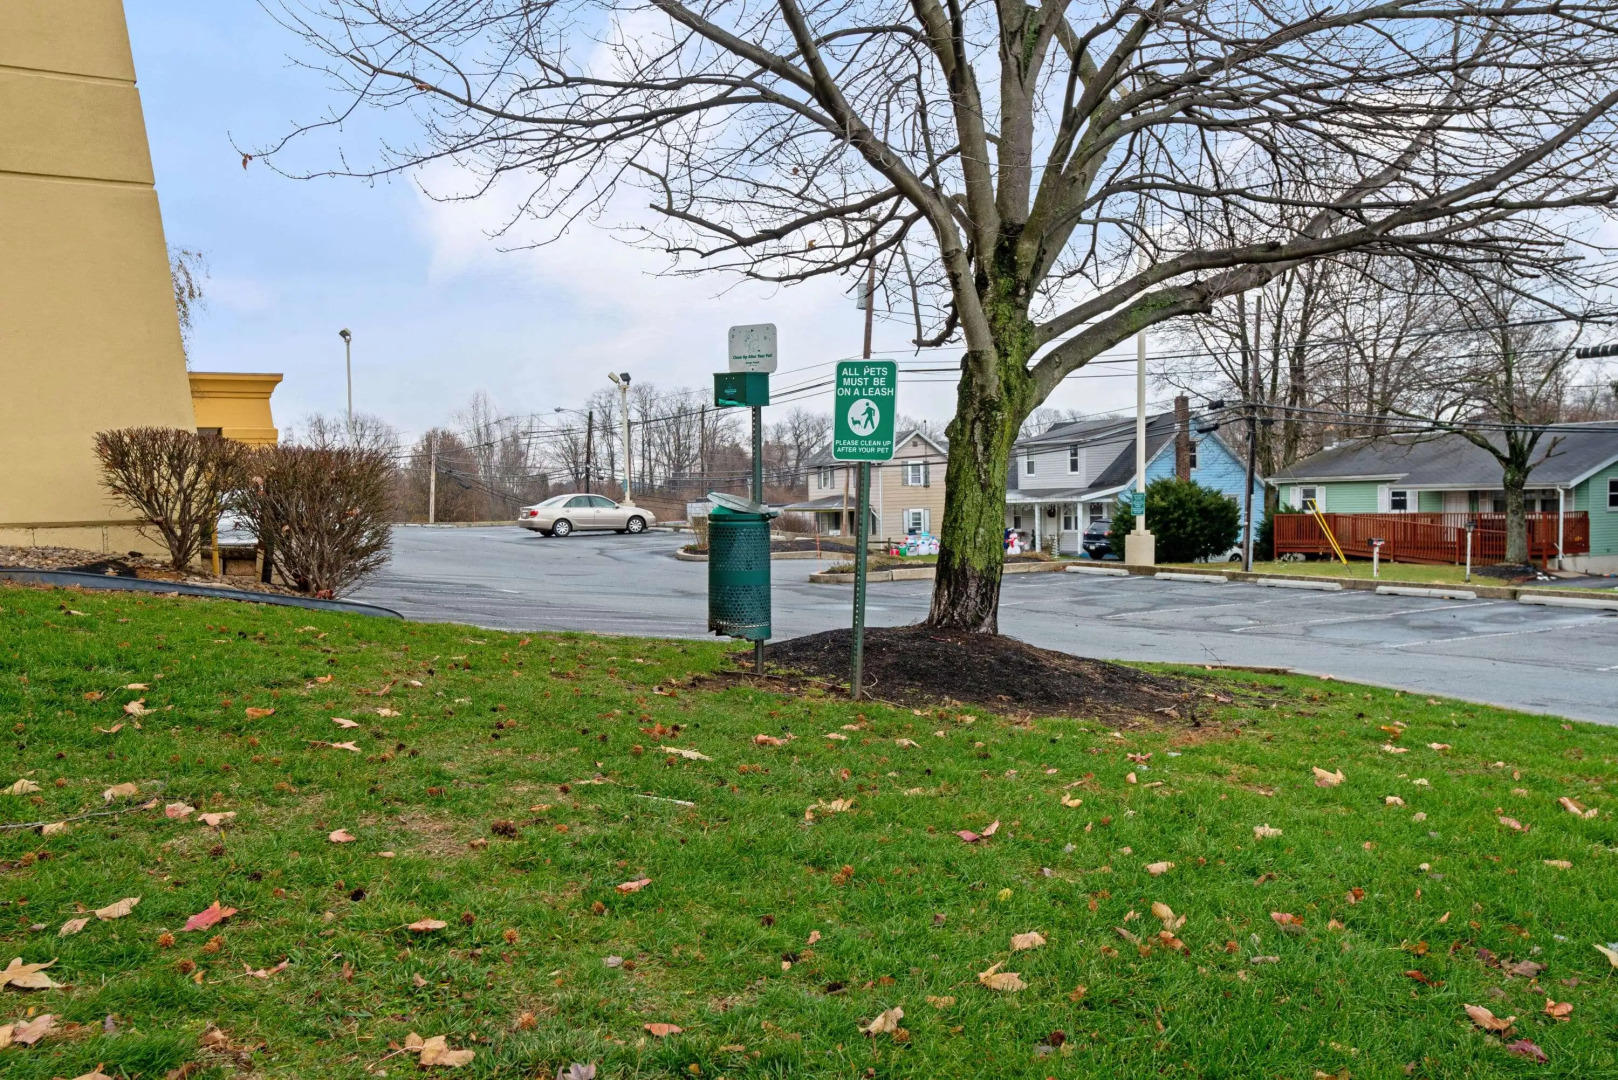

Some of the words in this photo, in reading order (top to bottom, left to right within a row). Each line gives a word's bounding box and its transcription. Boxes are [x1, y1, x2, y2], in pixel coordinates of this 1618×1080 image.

[842, 368, 860, 376] ALL
[864, 367, 888, 376] PETS
[842, 378, 869, 386] MUST
[873, 378, 886, 386] BE
[837, 388, 850, 396] ON
[854, 388, 860, 396] A
[862, 388, 894, 396] LEASH
